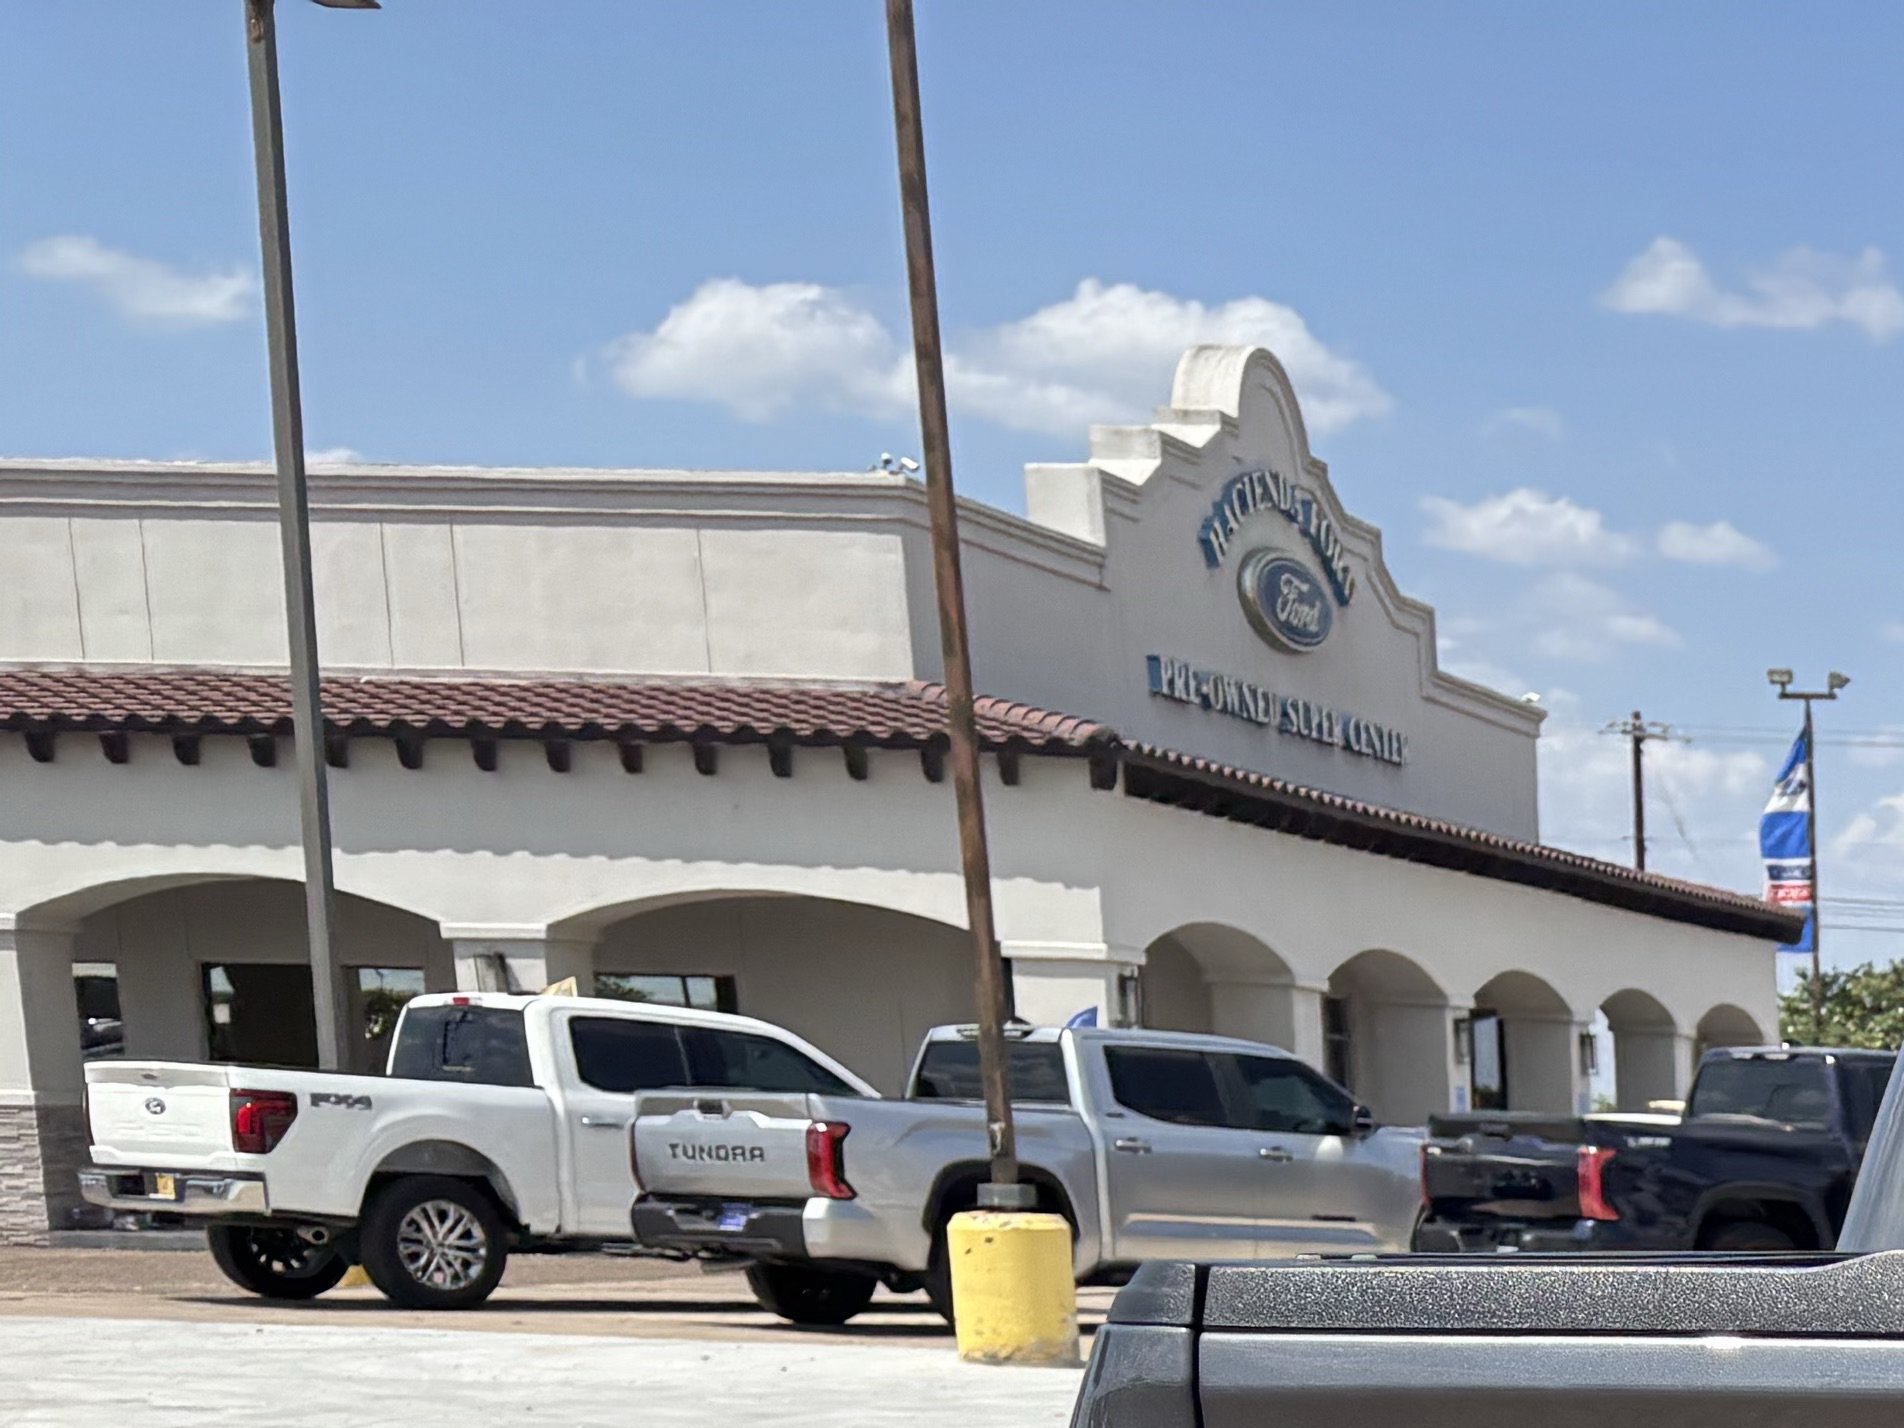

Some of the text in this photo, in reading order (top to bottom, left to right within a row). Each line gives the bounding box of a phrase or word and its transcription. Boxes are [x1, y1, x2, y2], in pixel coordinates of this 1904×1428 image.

[1276, 572, 1321, 633] Ford
[1155, 656, 1281, 727] PRE-OWNED
[668, 1143, 766, 1162] TUNDRA
